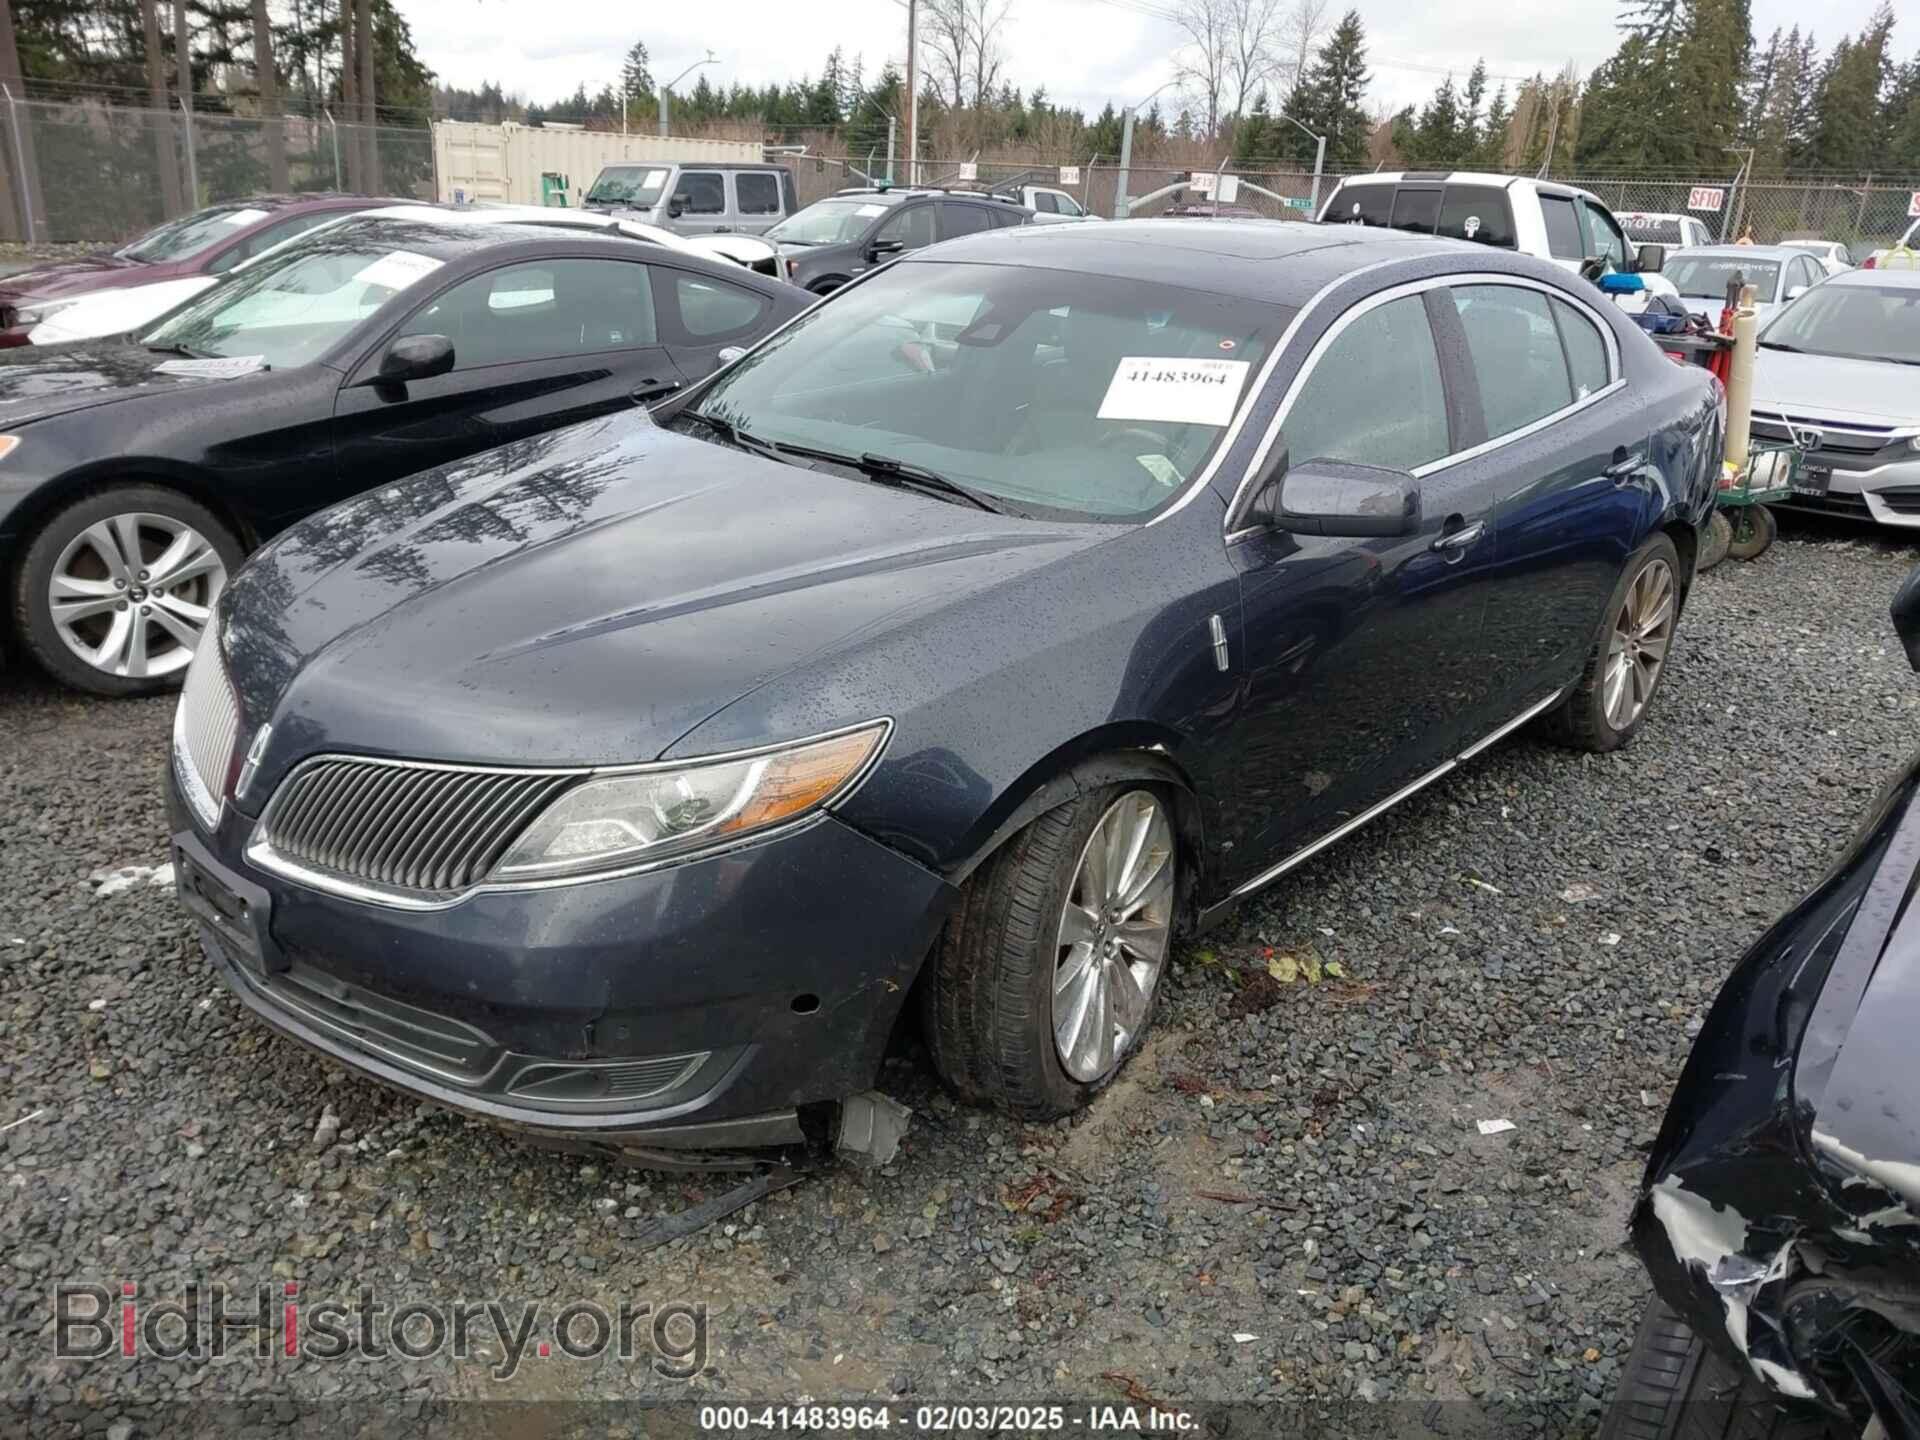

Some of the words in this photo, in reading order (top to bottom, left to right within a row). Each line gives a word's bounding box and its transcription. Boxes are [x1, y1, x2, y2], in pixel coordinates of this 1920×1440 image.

[1690, 190, 1721, 208] SF10
[1619, 218, 1662, 229] OYOTE
[1127, 371, 1228, 385] 41483964
